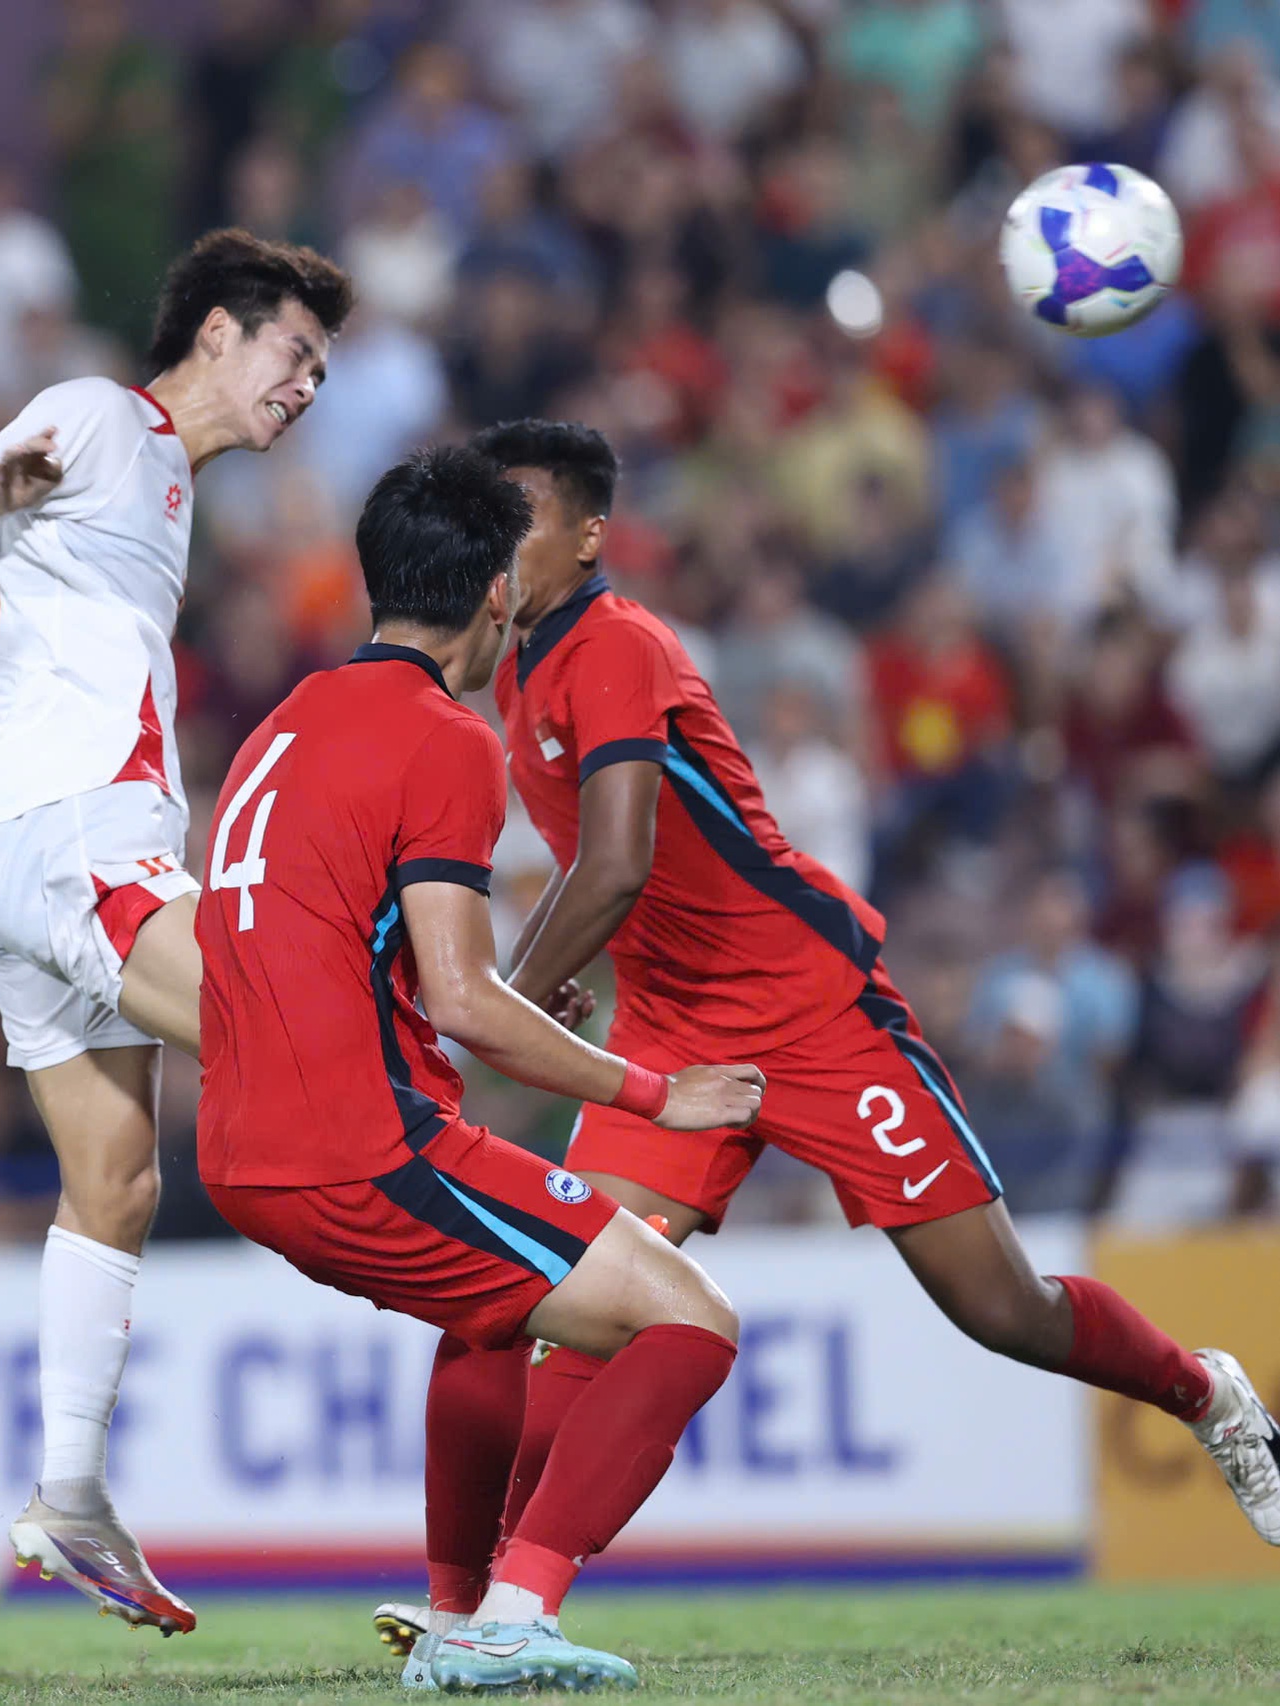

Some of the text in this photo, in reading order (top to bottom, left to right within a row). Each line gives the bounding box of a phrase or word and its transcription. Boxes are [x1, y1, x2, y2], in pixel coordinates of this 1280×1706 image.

[209, 733, 296, 931] 4
[857, 1086, 925, 1157] 2
[216, 1317, 898, 1480] CHEL
